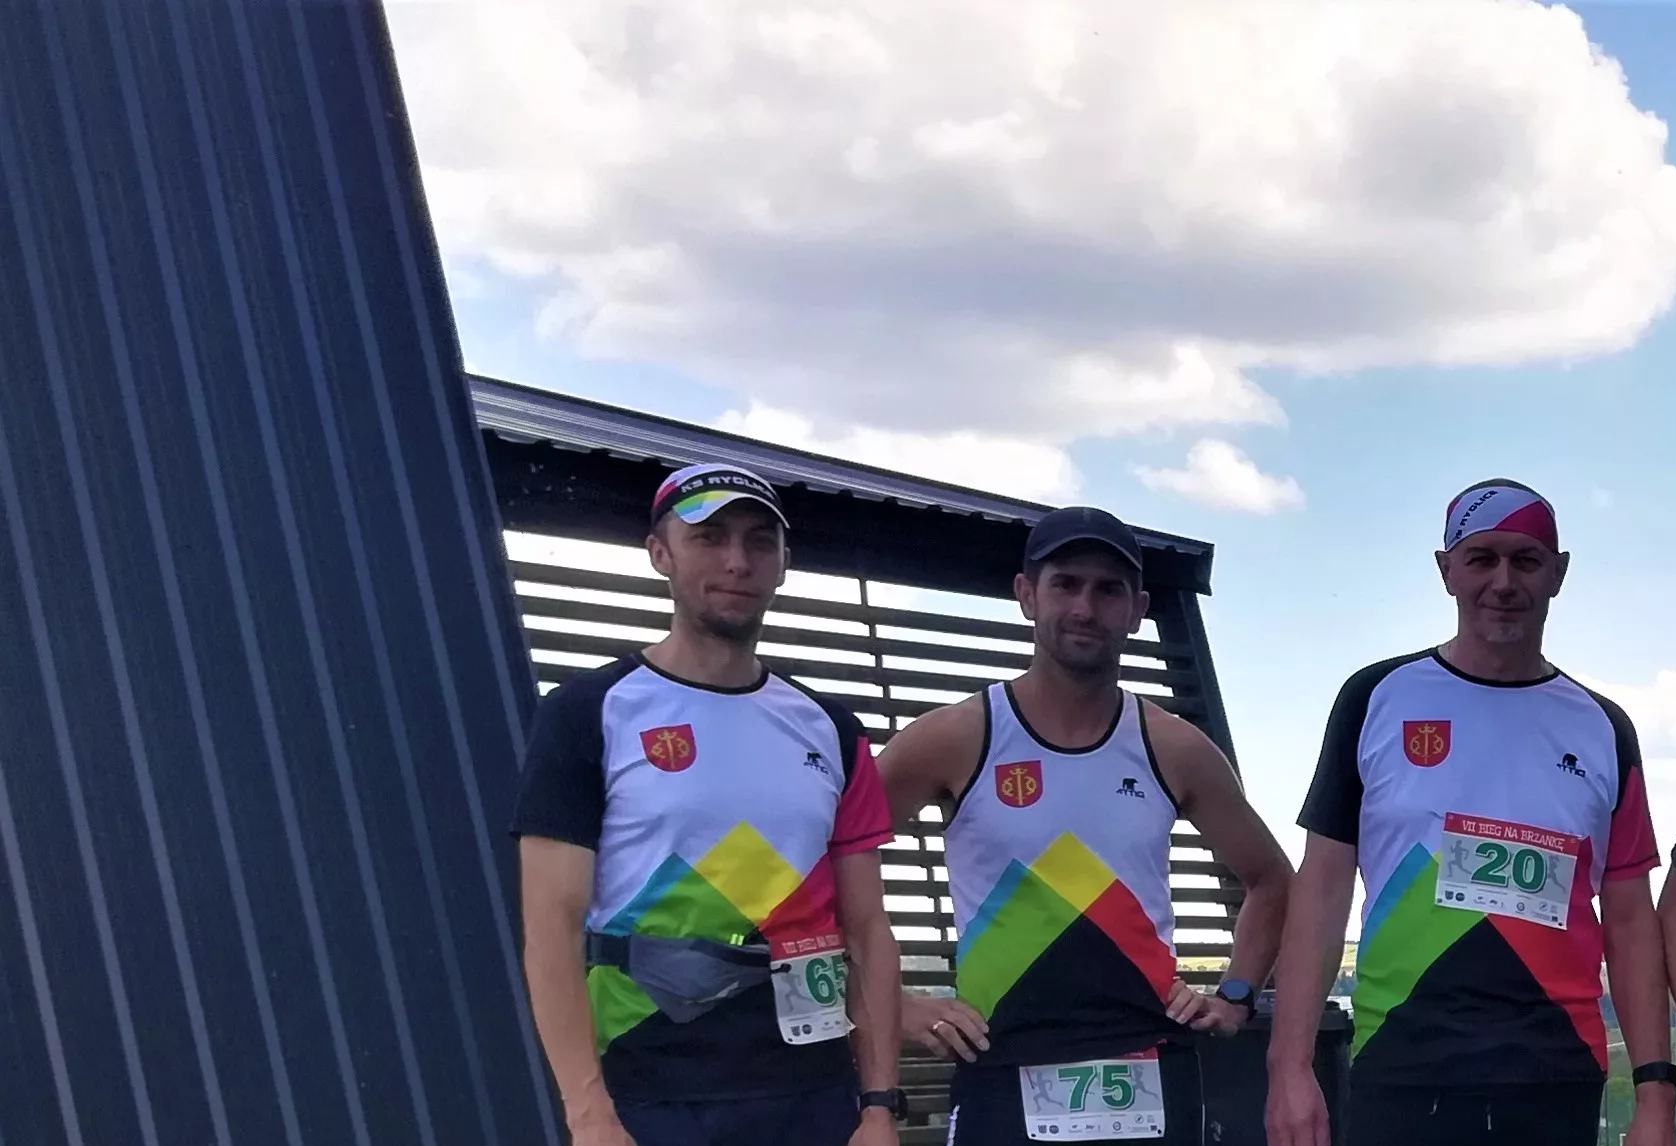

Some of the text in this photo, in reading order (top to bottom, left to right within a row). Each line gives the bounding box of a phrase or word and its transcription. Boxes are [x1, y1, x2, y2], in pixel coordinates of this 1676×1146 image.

[1462, 819, 1565, 852] VII BIEG NA BRZANKĘ
[1470, 841, 1549, 895] 20
[1057, 1063, 1137, 1113] 75
